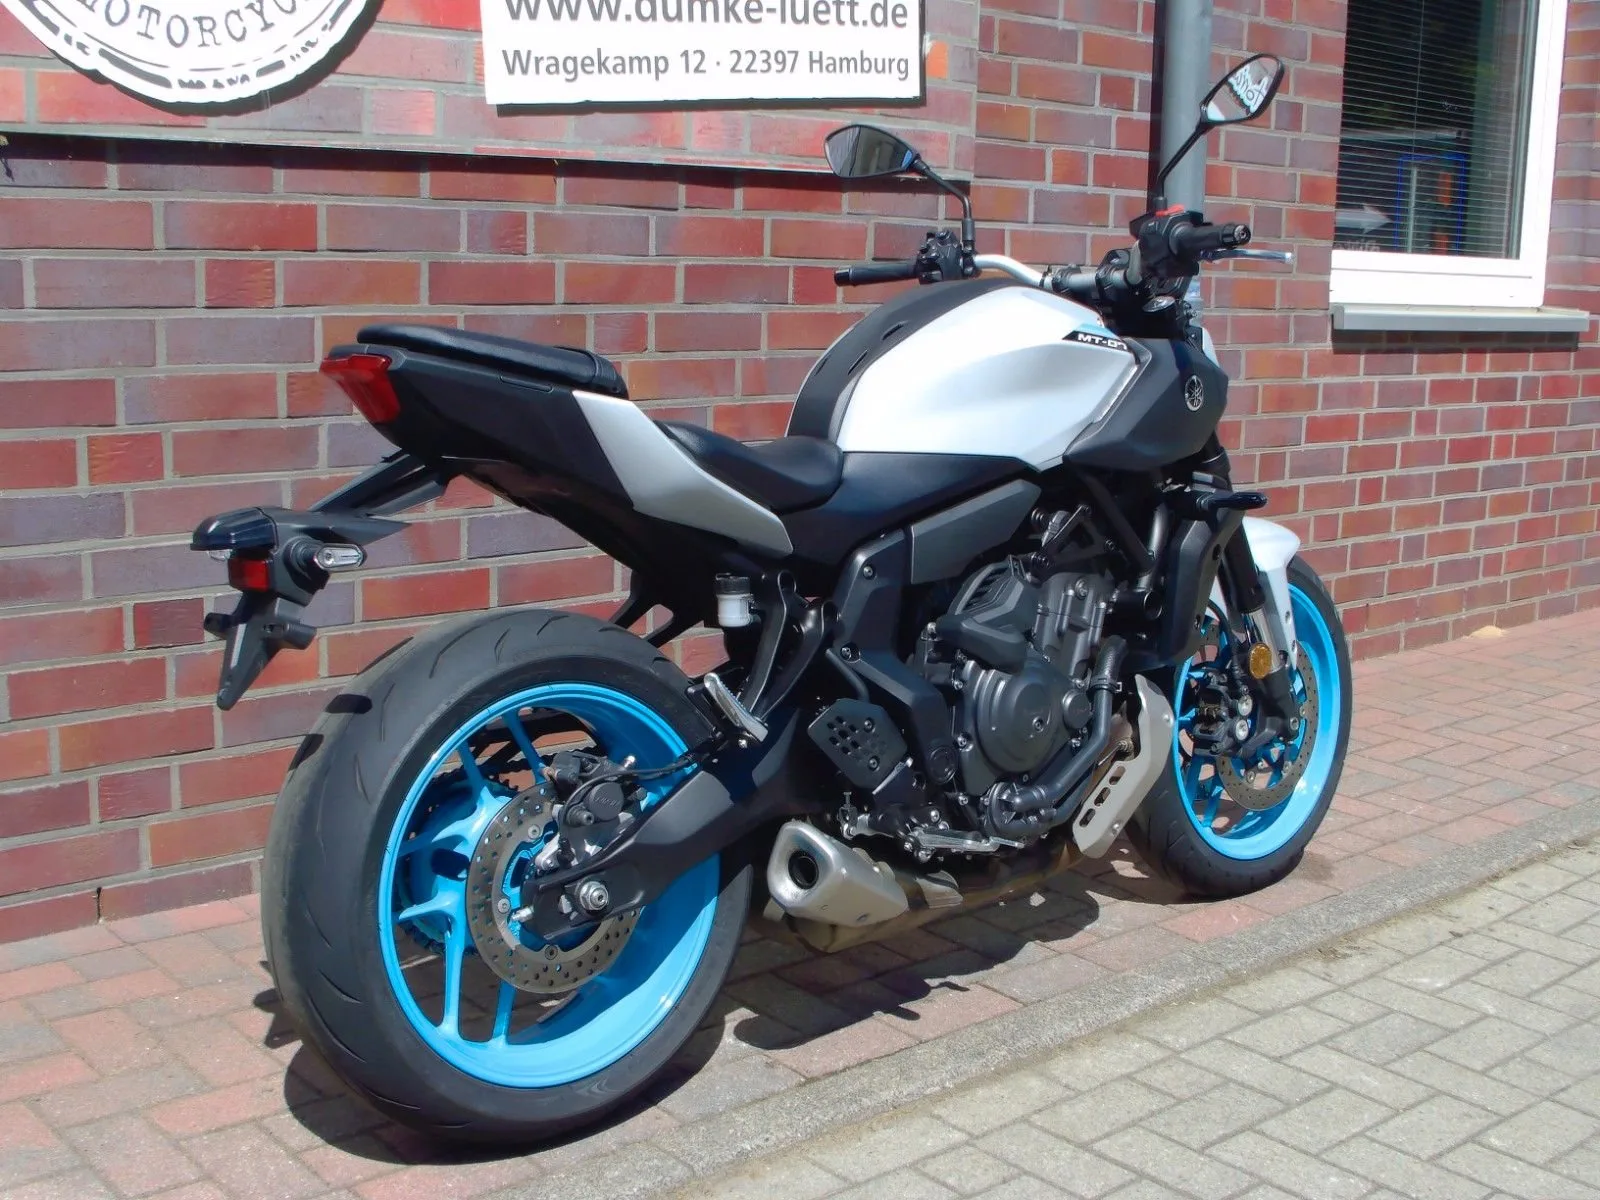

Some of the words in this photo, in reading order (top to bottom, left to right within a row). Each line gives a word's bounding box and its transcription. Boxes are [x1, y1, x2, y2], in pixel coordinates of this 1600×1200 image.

[77, 0, 296, 47] OTORCY
[504, 0, 908, 28] www.dumke-luett.de
[502, 48, 669, 83] Wragekamp
[680, 50, 707, 74] 12
[729, 50, 799, 74] 22397
[808, 50, 909, 81] Hamburg
